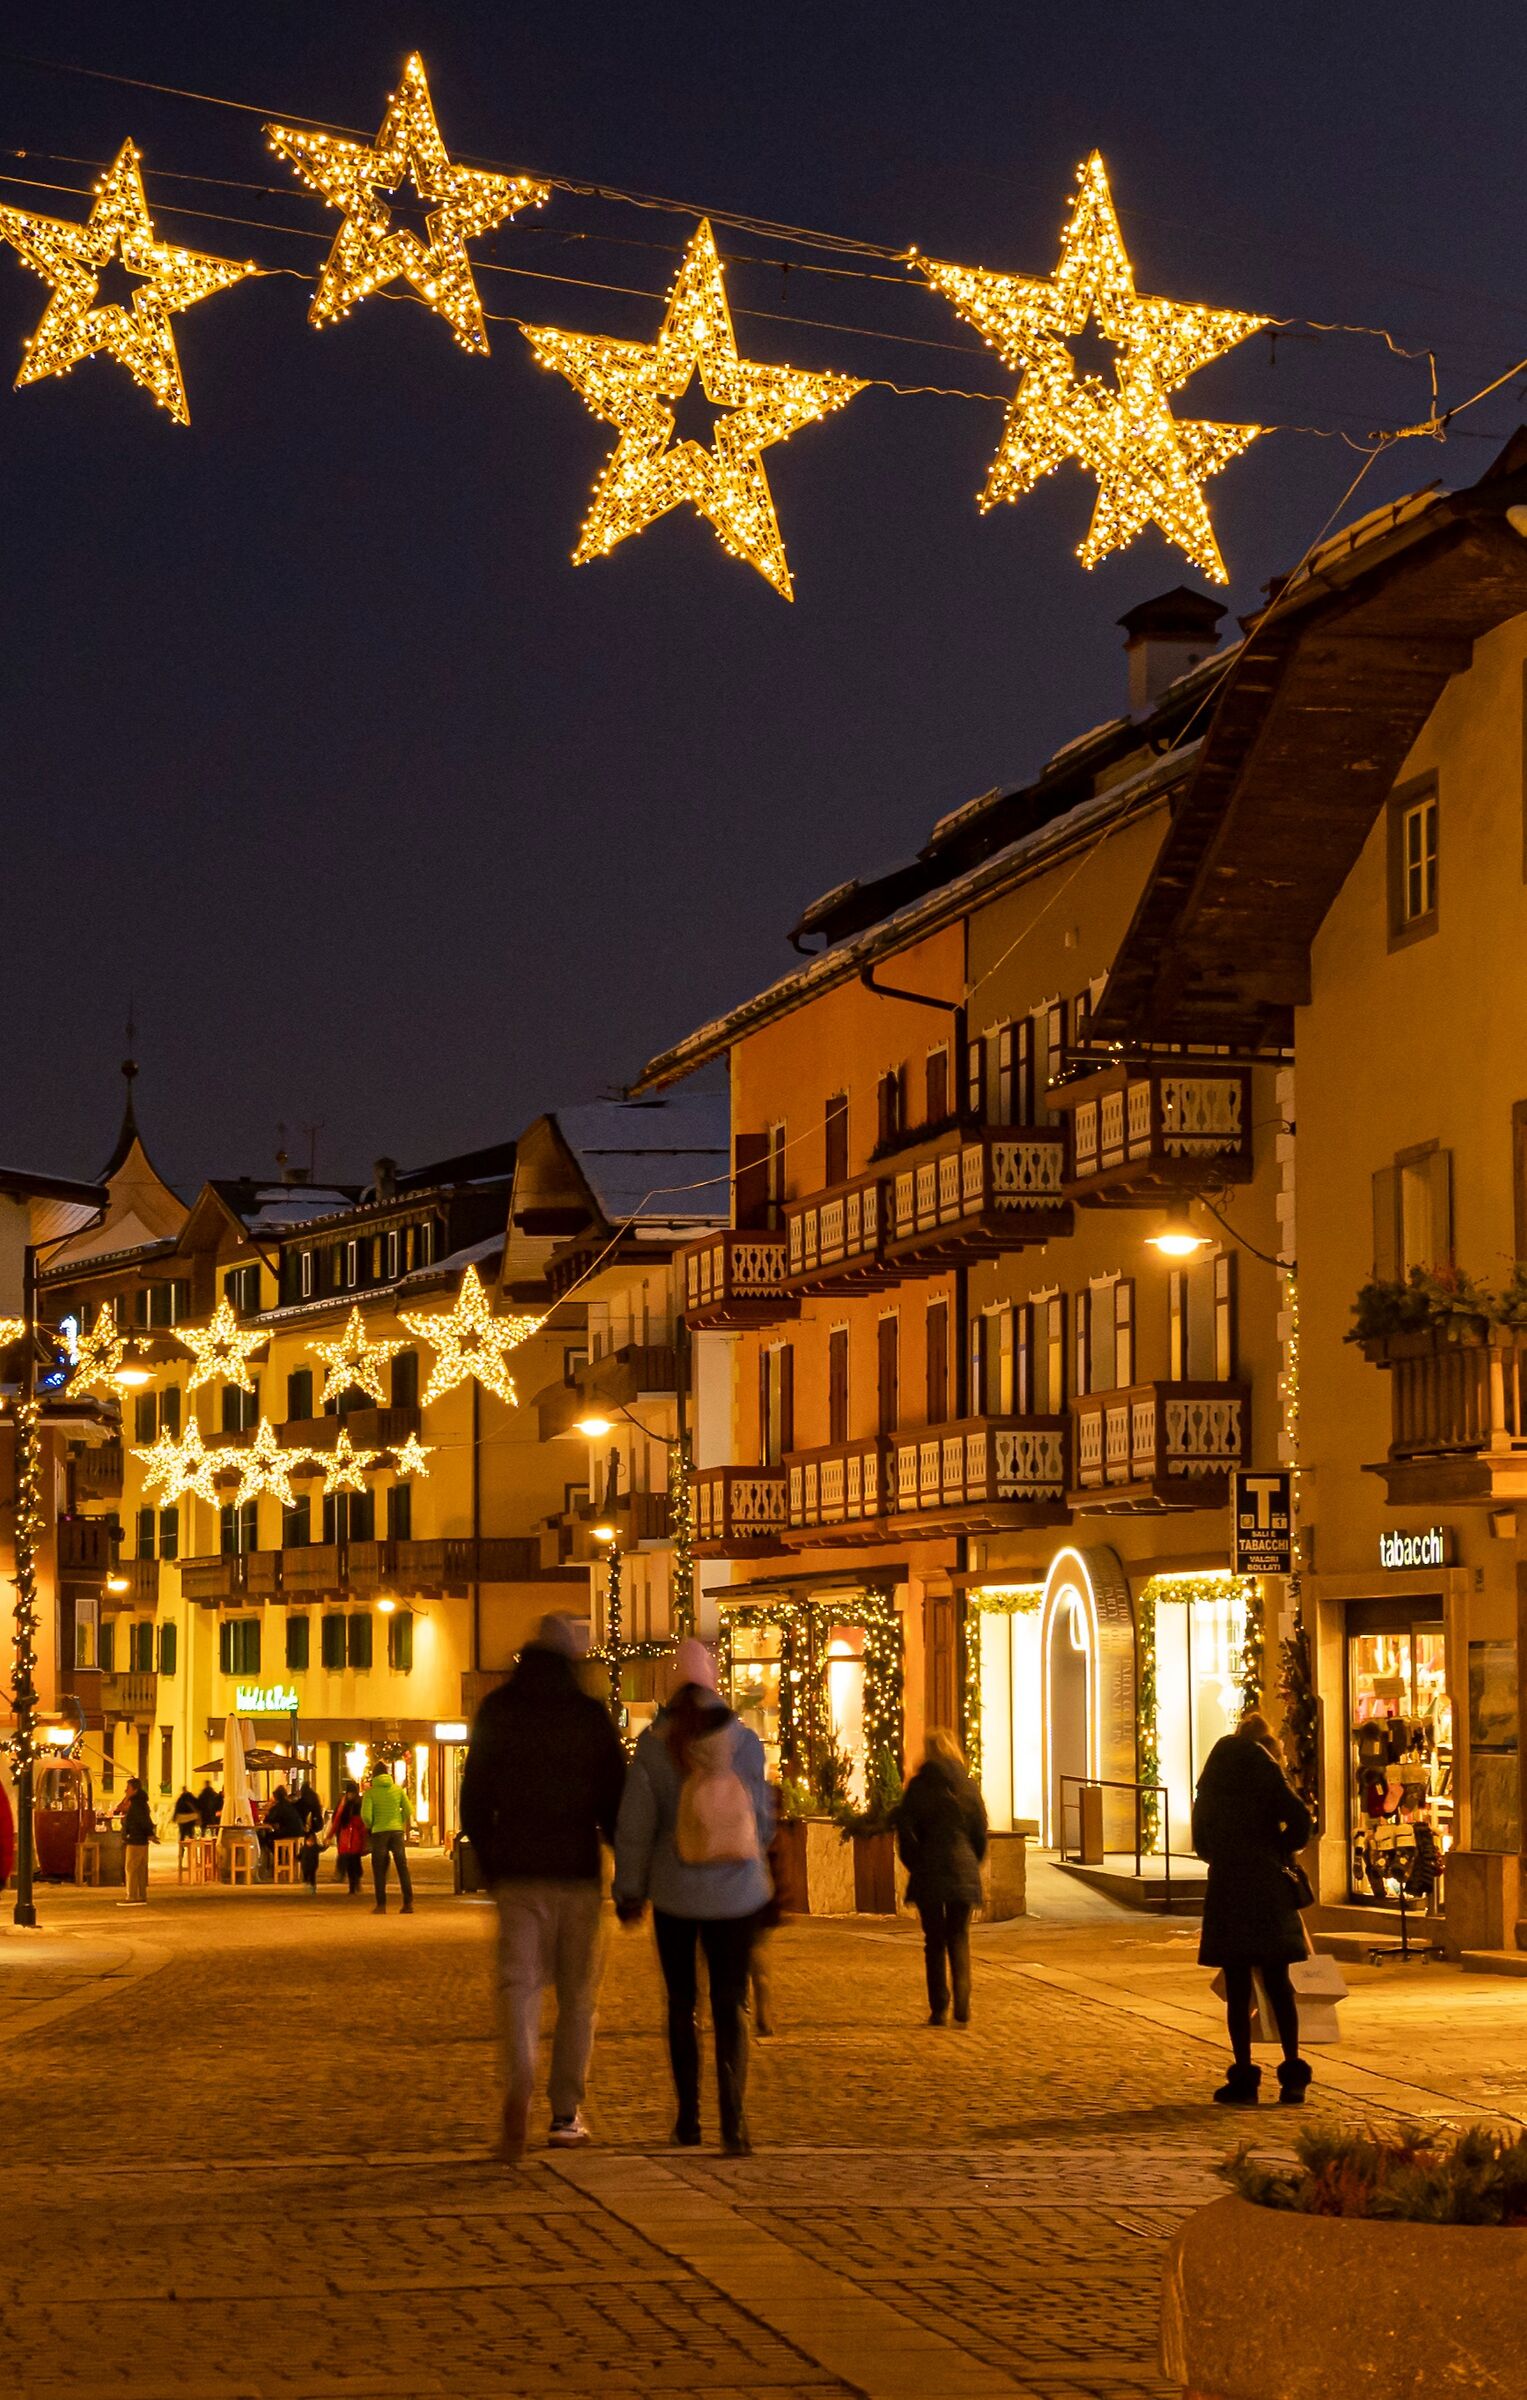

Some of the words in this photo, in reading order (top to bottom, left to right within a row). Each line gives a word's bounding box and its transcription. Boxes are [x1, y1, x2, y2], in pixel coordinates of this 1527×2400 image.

[1246, 1479, 1280, 1529] T
[1239, 1539, 1289, 1551] TABACCHI
[1380, 1526, 1443, 1568] tabacchi
